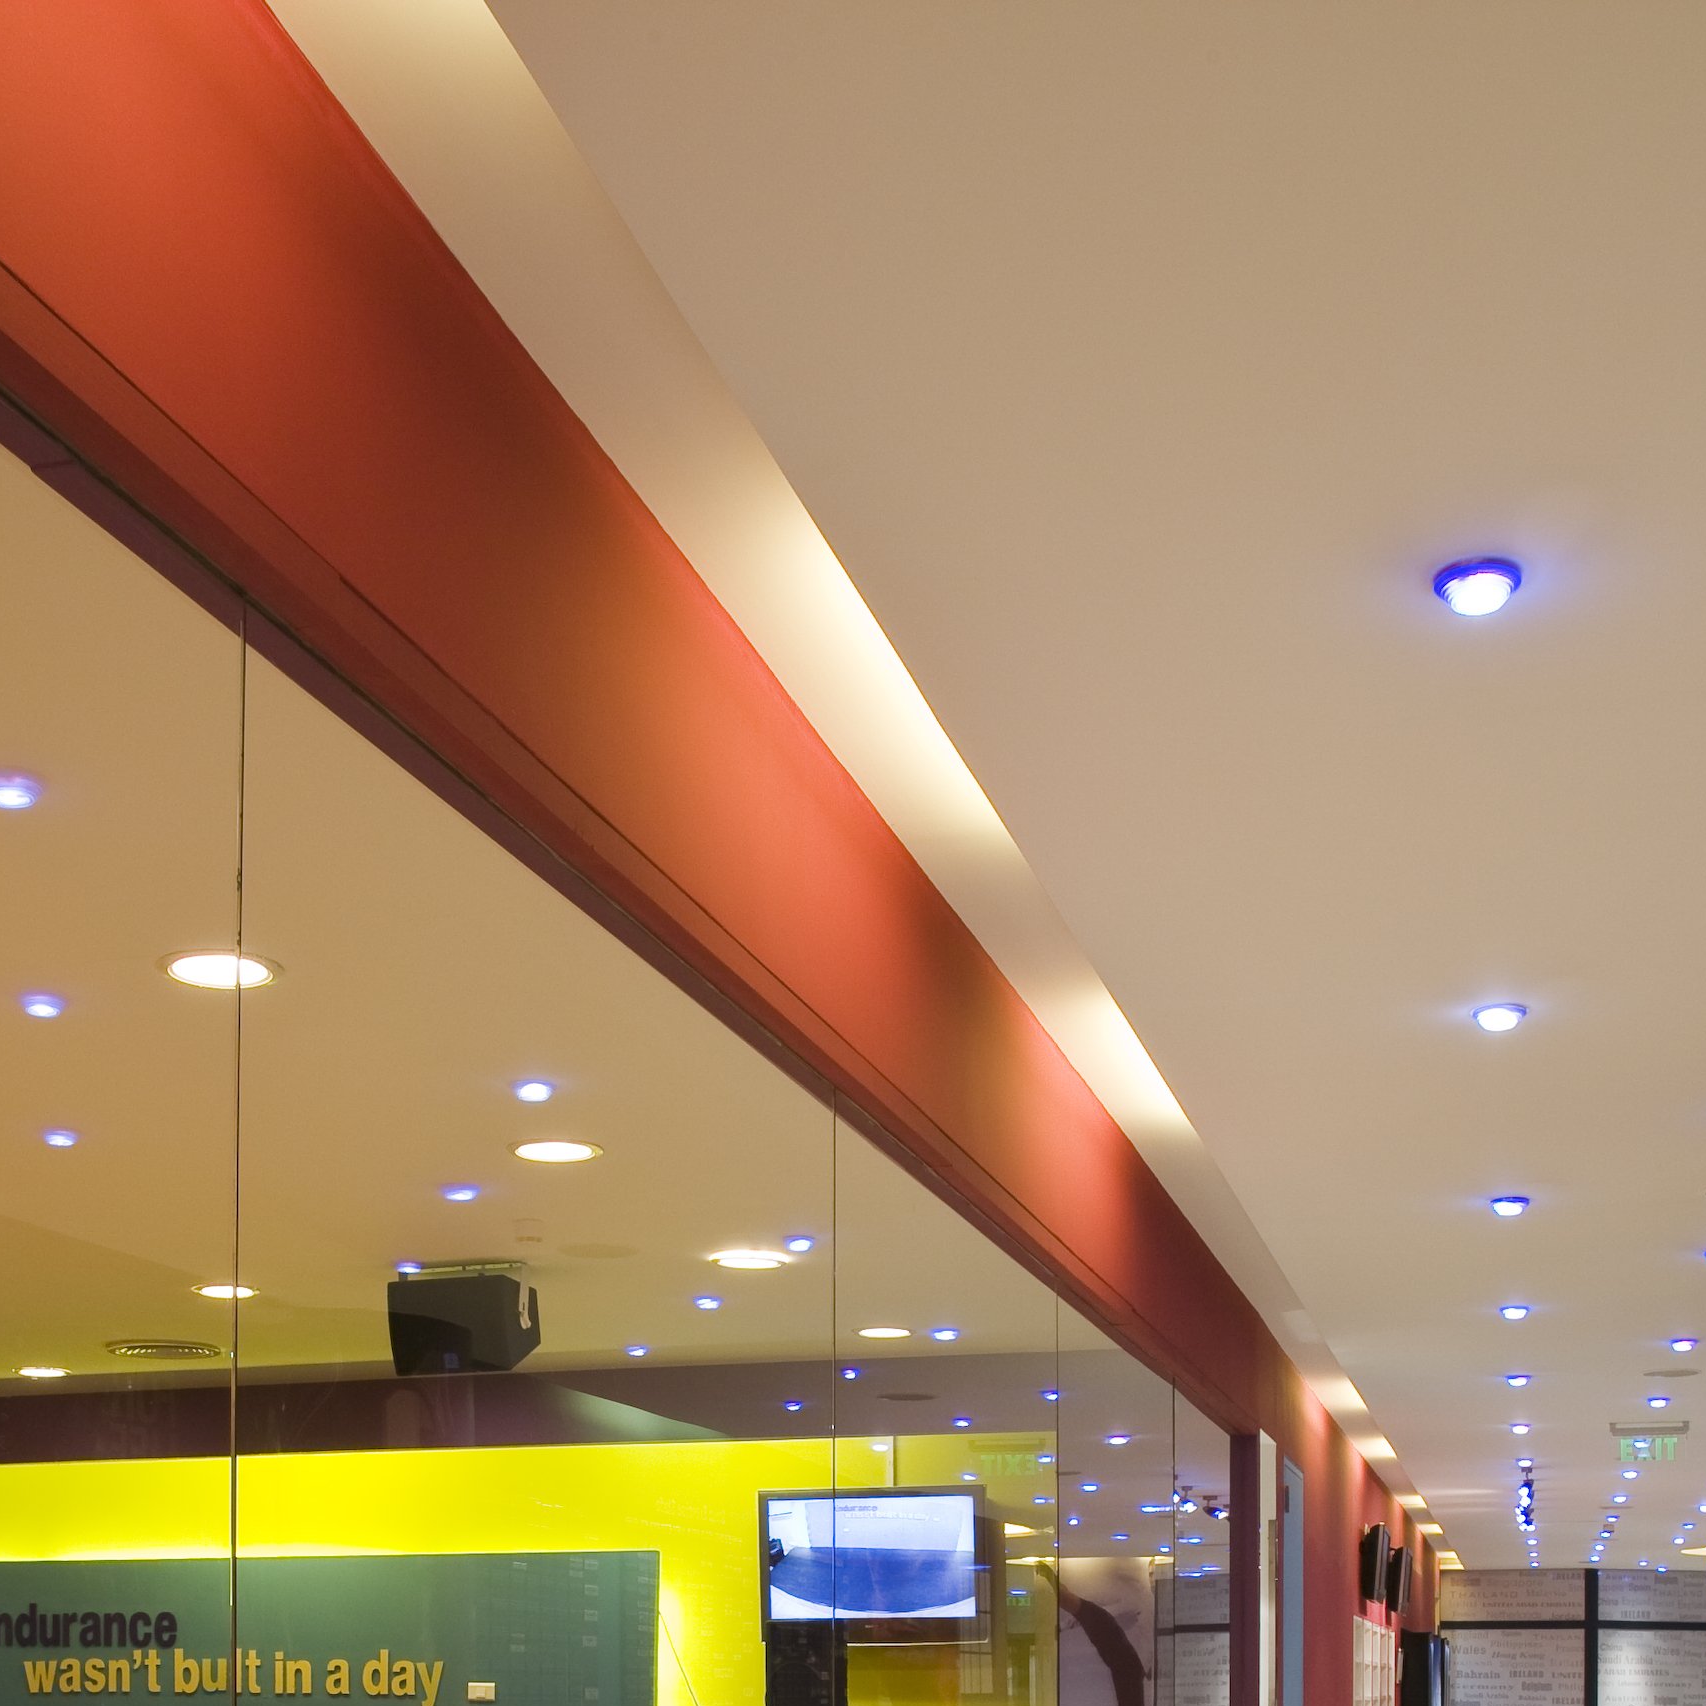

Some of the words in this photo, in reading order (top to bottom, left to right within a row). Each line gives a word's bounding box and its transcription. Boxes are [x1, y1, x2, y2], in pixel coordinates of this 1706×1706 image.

[1619, 1437, 1677, 1461] EXIT
[273, 1650, 313, 1696] in
[325, 1658, 350, 1696] a
[1455, 1670, 1501, 1679] Bahrain
